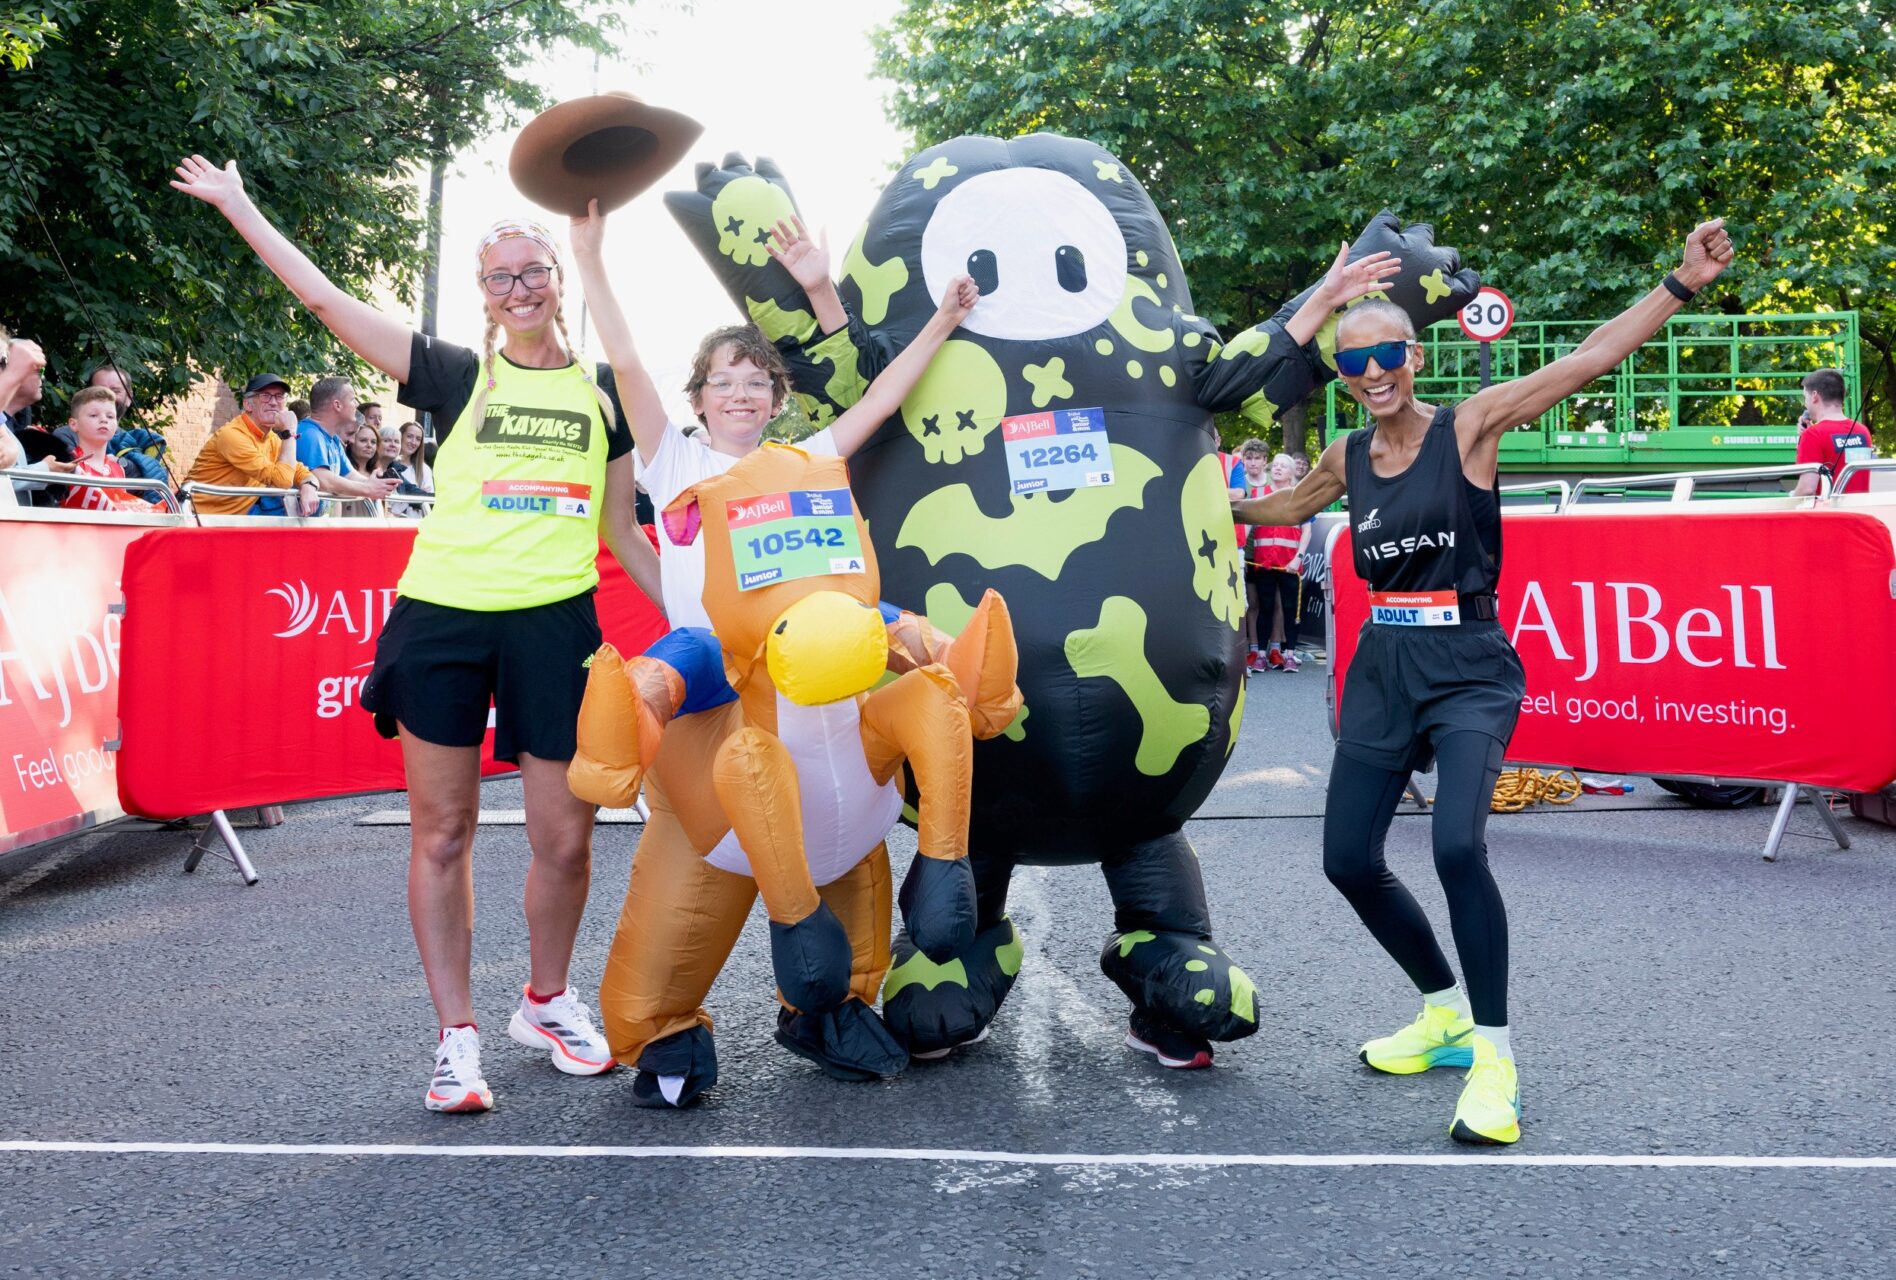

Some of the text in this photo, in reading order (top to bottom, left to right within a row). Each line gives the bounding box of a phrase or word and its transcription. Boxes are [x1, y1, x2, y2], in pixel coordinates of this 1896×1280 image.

[1466, 303, 1506, 325] 30
[486, 405, 511, 417] THE
[498, 415, 582, 442] KAYAKS
[1835, 435, 1863, 448] Event
[1019, 442, 1098, 469] 12264
[508, 484, 569, 494] ACCOMPANYING
[1016, 480, 1045, 491] junior
[1100, 473, 1110, 483] B
[487, 496, 551, 512] ADULT
[576, 503, 586, 515] A
[747, 527, 846, 559] 10542
[744, 569, 779, 586] junior
[848, 559, 861, 571] A
[1386, 595, 1433, 604] ACCOMPANYING
[1377, 609, 1419, 623] ADULT
[1443, 611, 1453, 621] B
[1520, 690, 1796, 735] eel good, investing.
[12, 747, 64, 793] Feel
